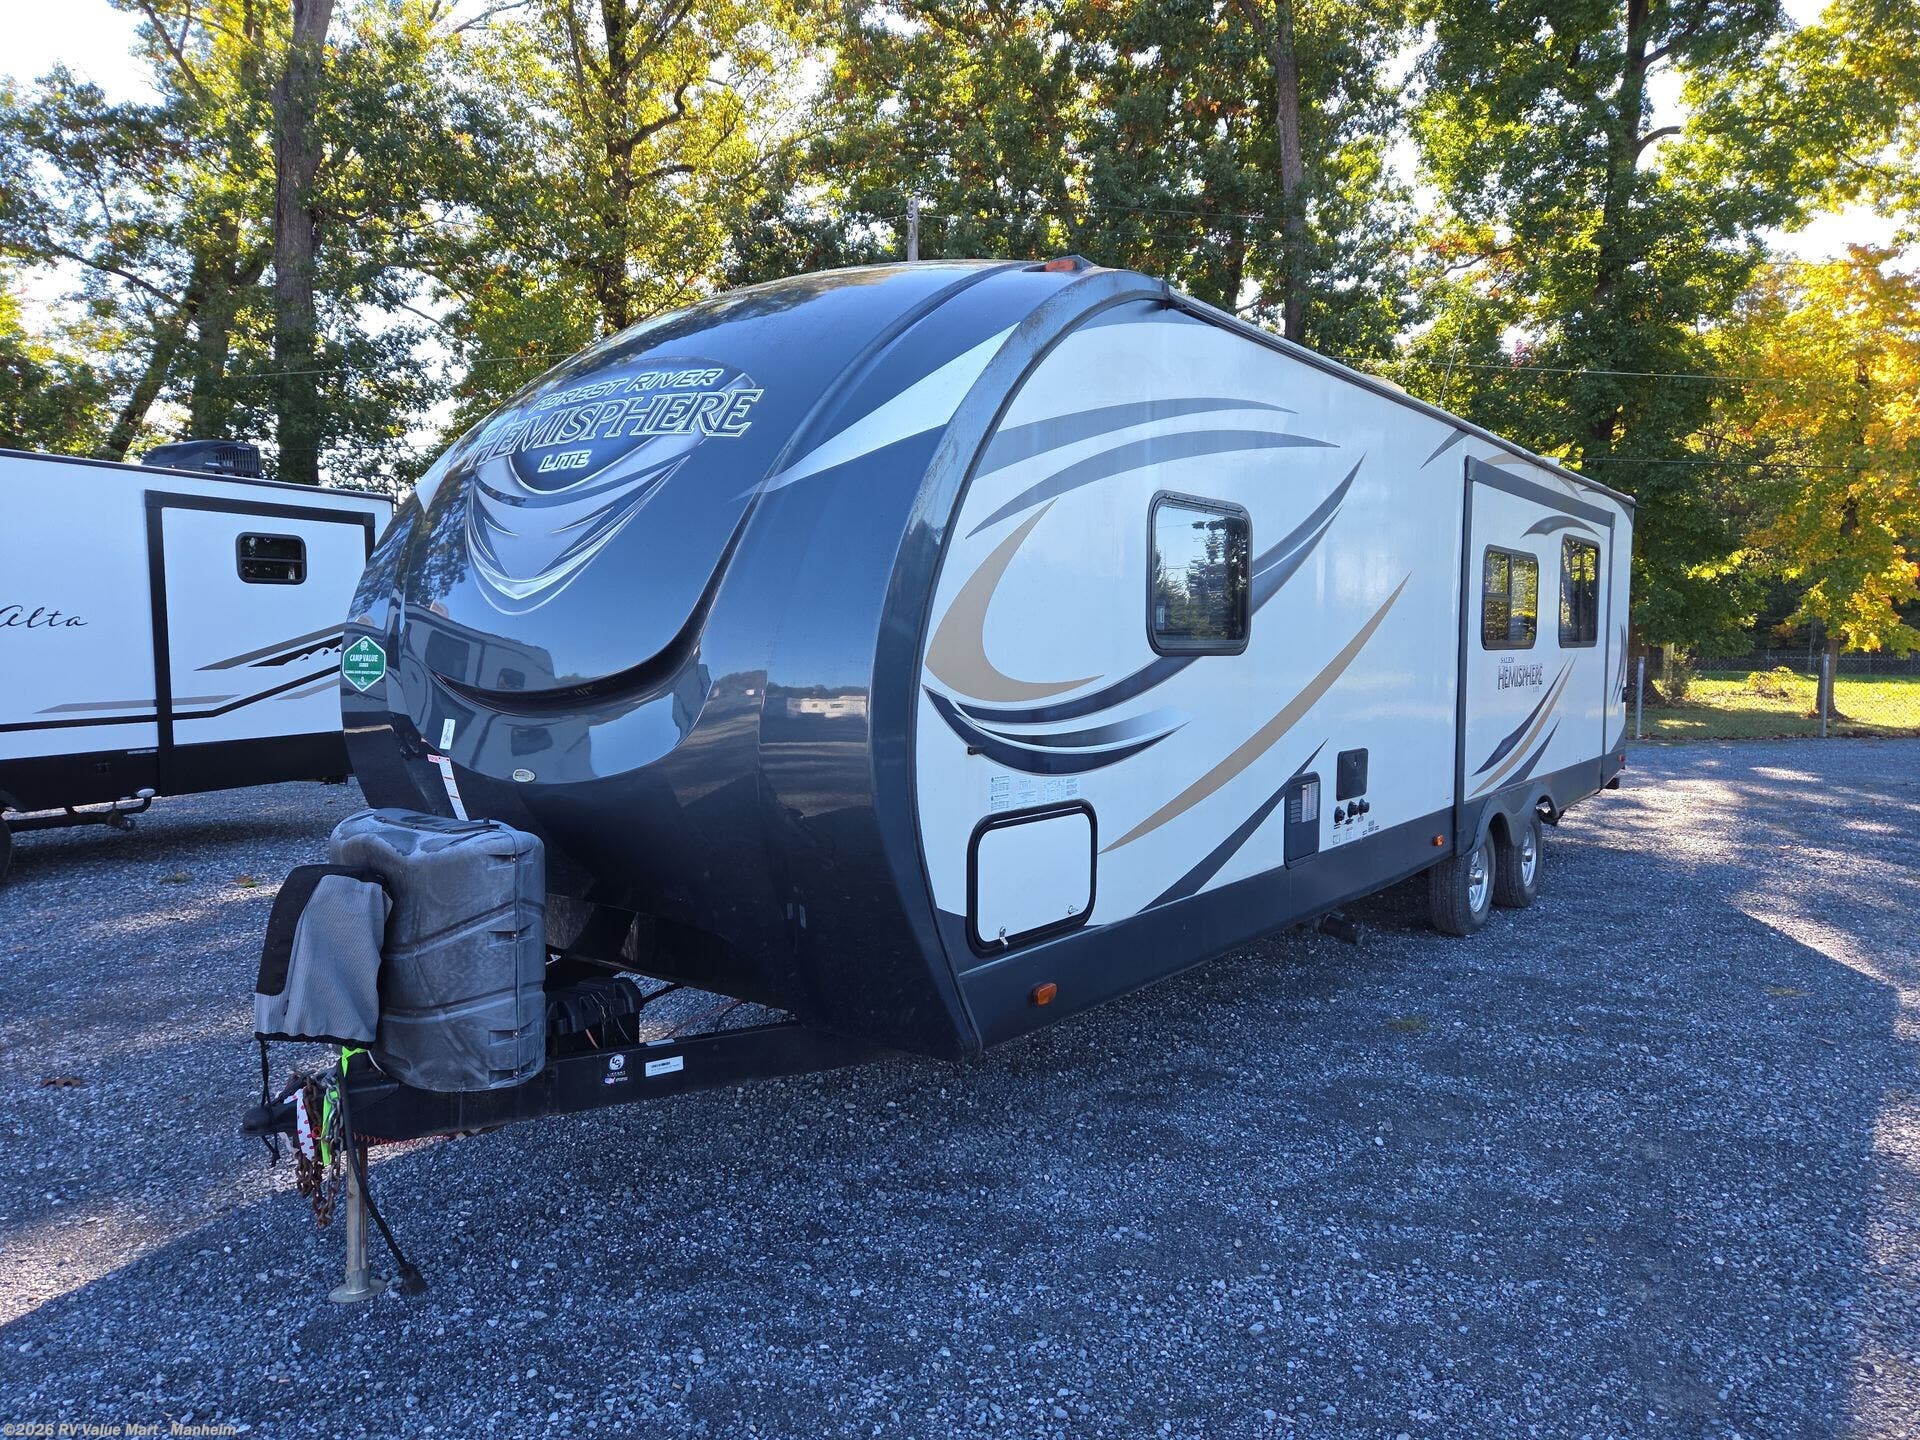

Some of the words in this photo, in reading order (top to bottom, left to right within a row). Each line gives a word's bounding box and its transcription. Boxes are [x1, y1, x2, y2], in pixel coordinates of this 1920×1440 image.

[527, 377, 629, 415] FOREST
[624, 368, 724, 393] RIVER
[461, 388, 765, 473] HEMISPHERE
[537, 449, 592, 473] LITE
[1497, 664, 1543, 690] HEMISPHERE
